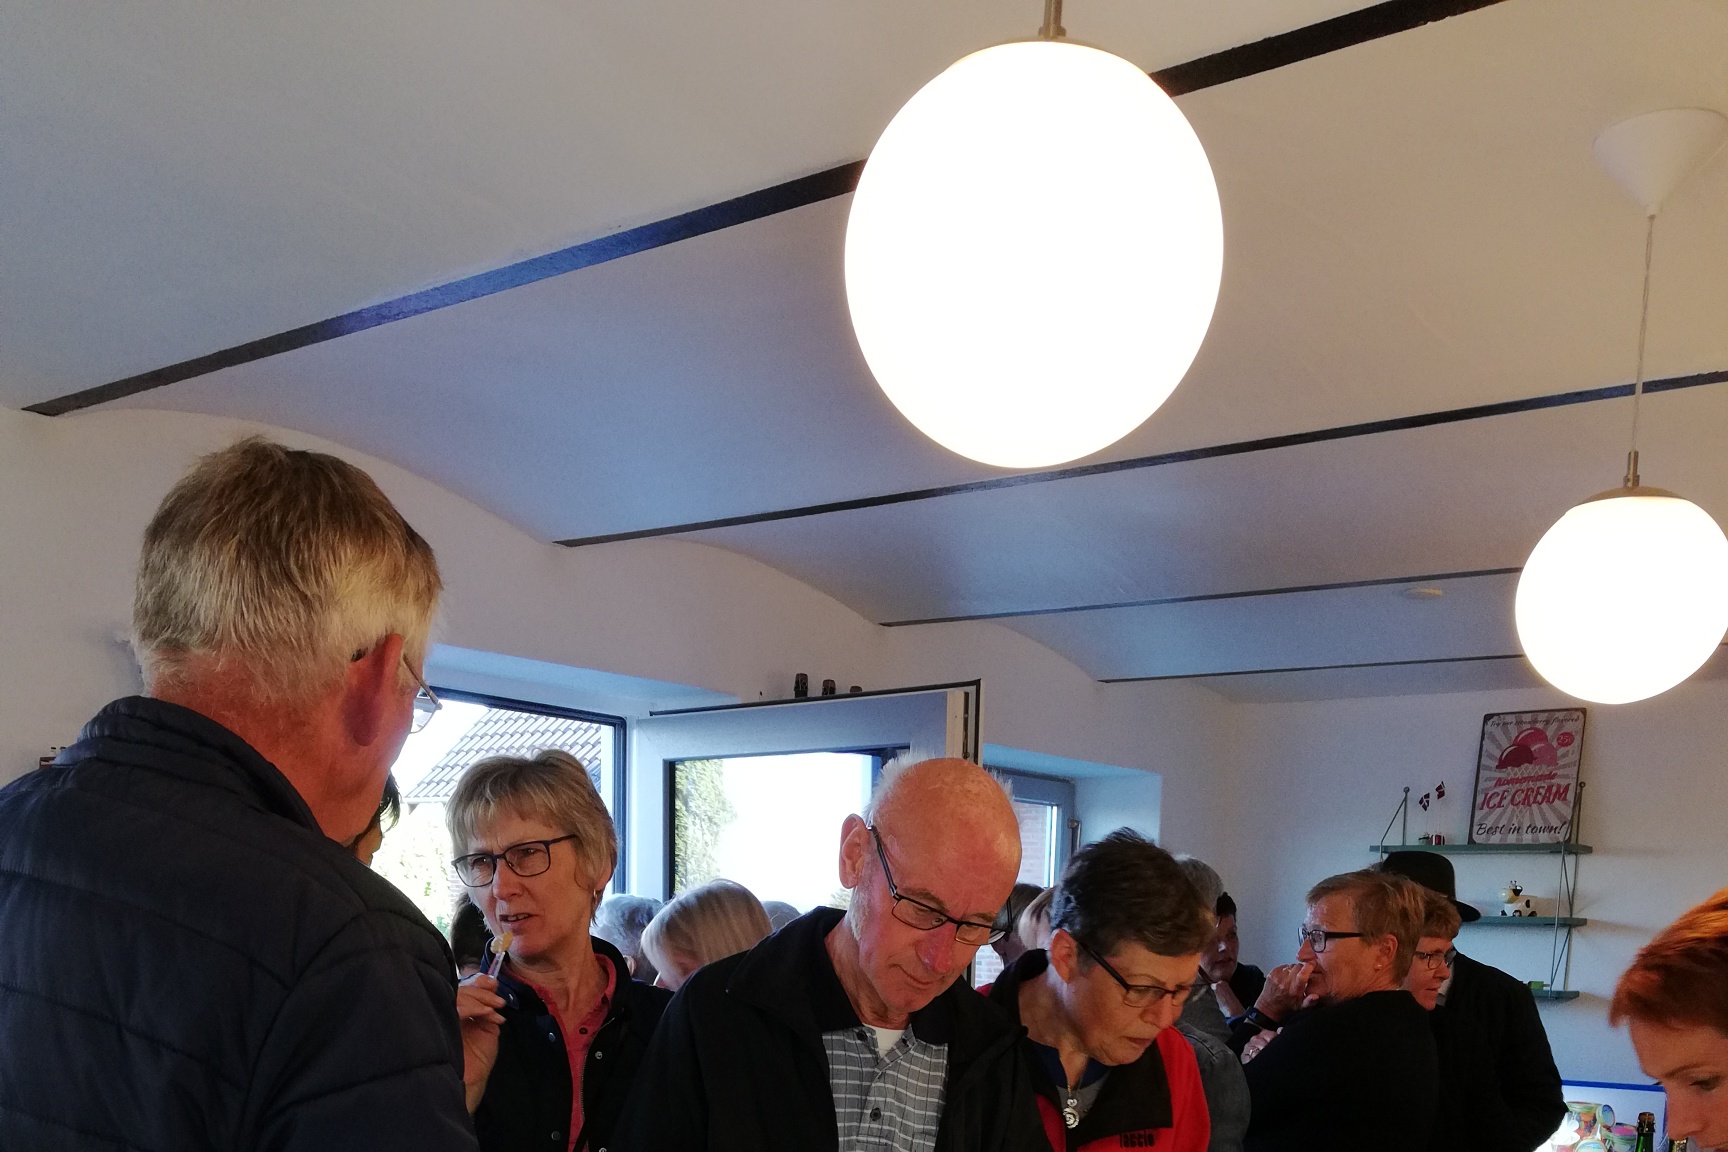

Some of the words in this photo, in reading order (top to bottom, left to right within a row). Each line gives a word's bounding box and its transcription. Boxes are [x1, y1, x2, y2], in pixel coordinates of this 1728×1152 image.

[1494, 772, 1557, 786] homemade
[1480, 791, 1508, 810] ICE
[1511, 783, 1571, 807] CREAM
[1476, 823, 1506, 836] Best
[1508, 823, 1521, 835] in
[1525, 820, 1568, 835] town!
